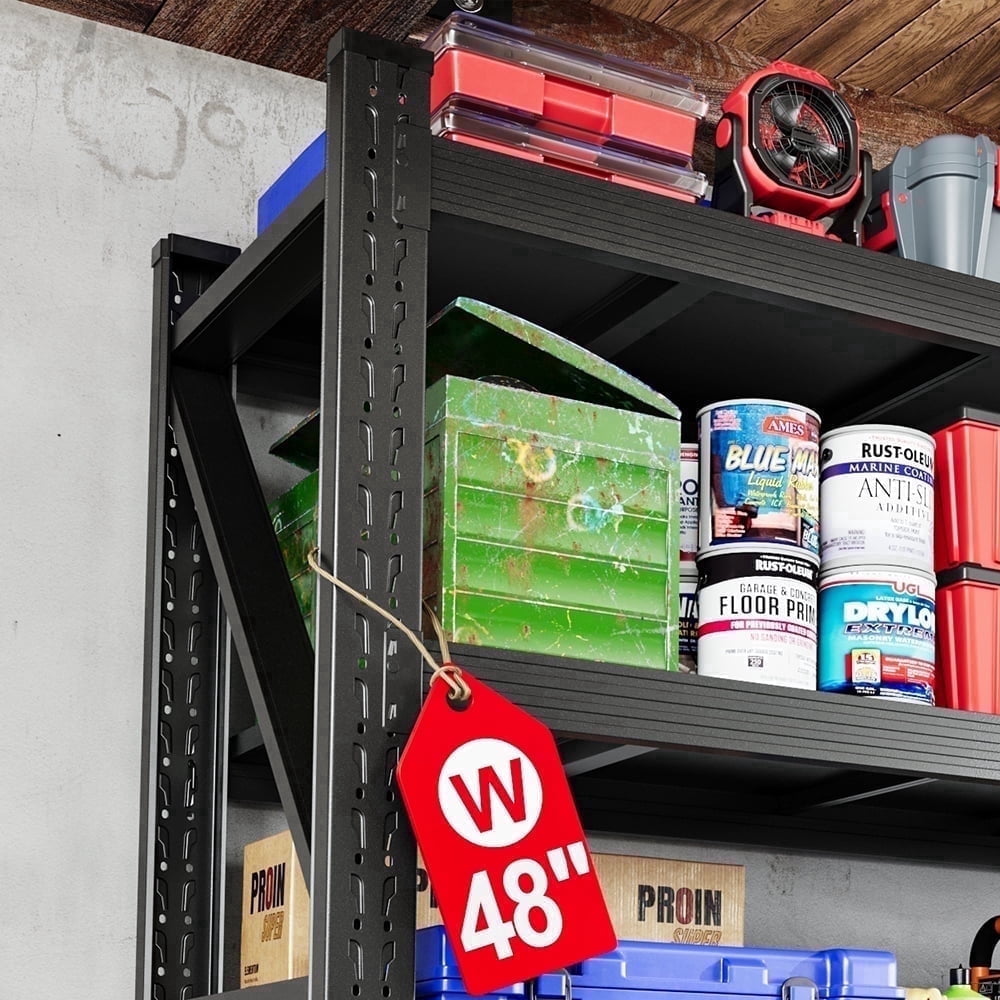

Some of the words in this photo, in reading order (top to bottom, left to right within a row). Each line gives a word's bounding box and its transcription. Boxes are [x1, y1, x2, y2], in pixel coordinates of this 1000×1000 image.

[768, 420, 805, 436] AMES
[725, 443, 790, 473] BLUE
[791, 447, 819, 478] MA
[849, 463, 901, 474] MARINE
[747, 470, 783, 491] Liquid
[755, 558, 813, 581] RUST-OLEUM
[739, 583, 778, 596] GARAGE
[780, 586, 787, 596] &
[894, 581, 922, 596] UGL
[719, 595, 780, 616] FLOOR
[843, 622, 935, 640] EXTREM
[847, 634, 893, 643] MASONRY
[447, 757, 528, 835] W
[249, 862, 286, 915] PROIN
[460, 840, 590, 961] 48"
[637, 884, 722, 927] PROIN
